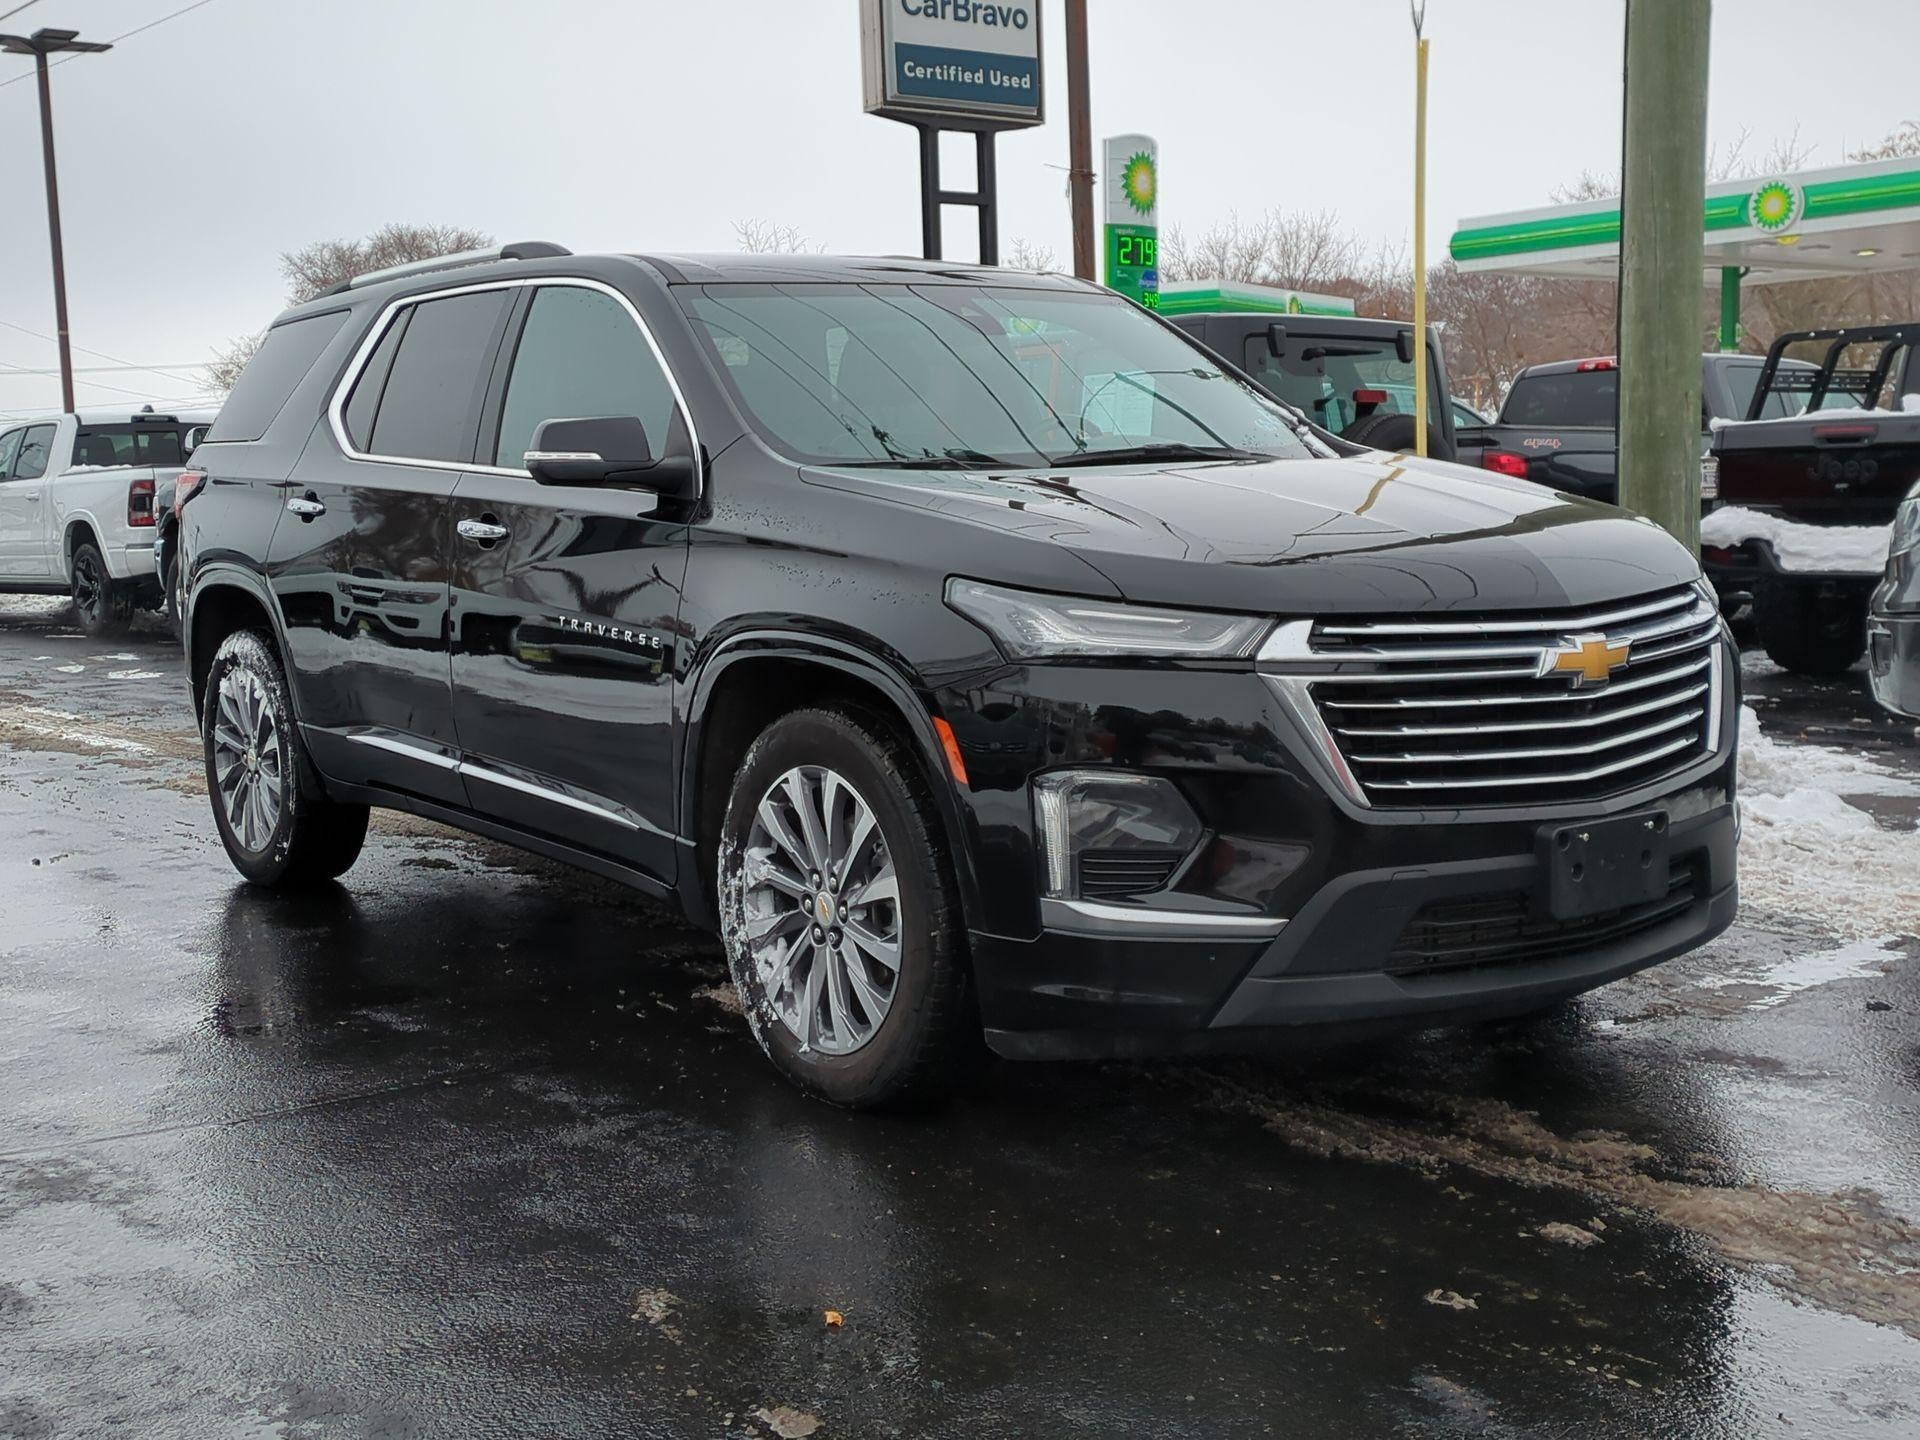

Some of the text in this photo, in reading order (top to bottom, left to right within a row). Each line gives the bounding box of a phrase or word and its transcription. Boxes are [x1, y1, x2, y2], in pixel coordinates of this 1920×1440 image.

[901, 0, 1029, 30] CarBravo
[903, 61, 1031, 89] Certified Used
[1807, 452, 1879, 486] Jeep
[559, 615, 661, 649] TRAVERSE
